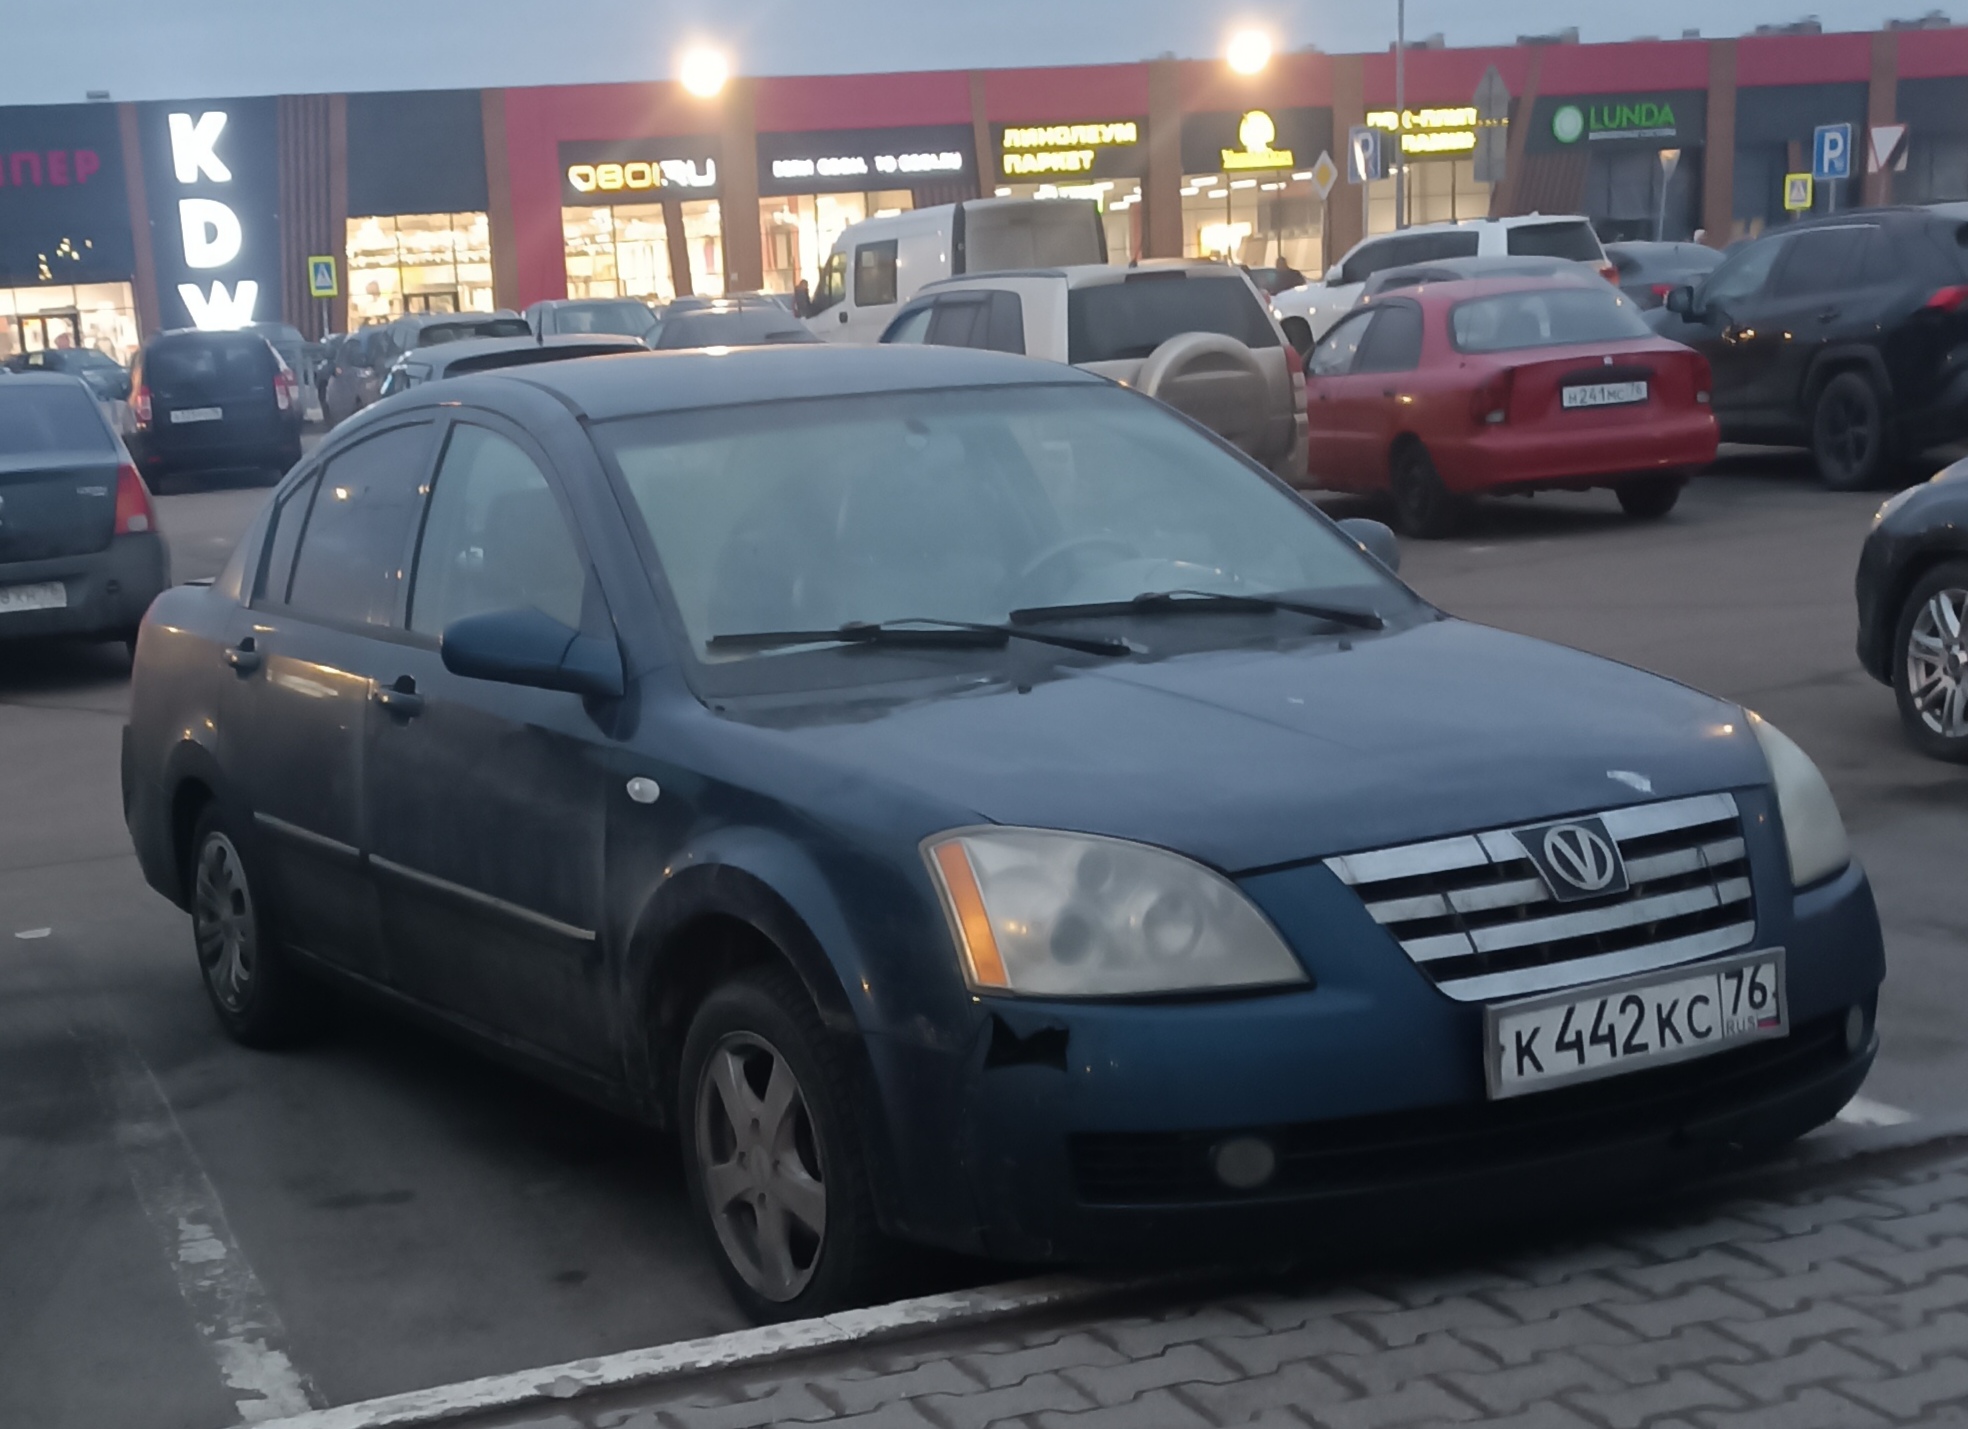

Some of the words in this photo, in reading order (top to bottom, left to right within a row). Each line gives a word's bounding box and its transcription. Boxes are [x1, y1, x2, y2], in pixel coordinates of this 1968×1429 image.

[1589, 101, 1676, 130] LUNDA
[1003, 122, 1137, 148] ЛИНОЛЕУМ
[1003, 150, 1095, 174] ПАРКЕТ
[1823, 132, 1844, 173] P
[0, 150, 100, 187] ПЕР
